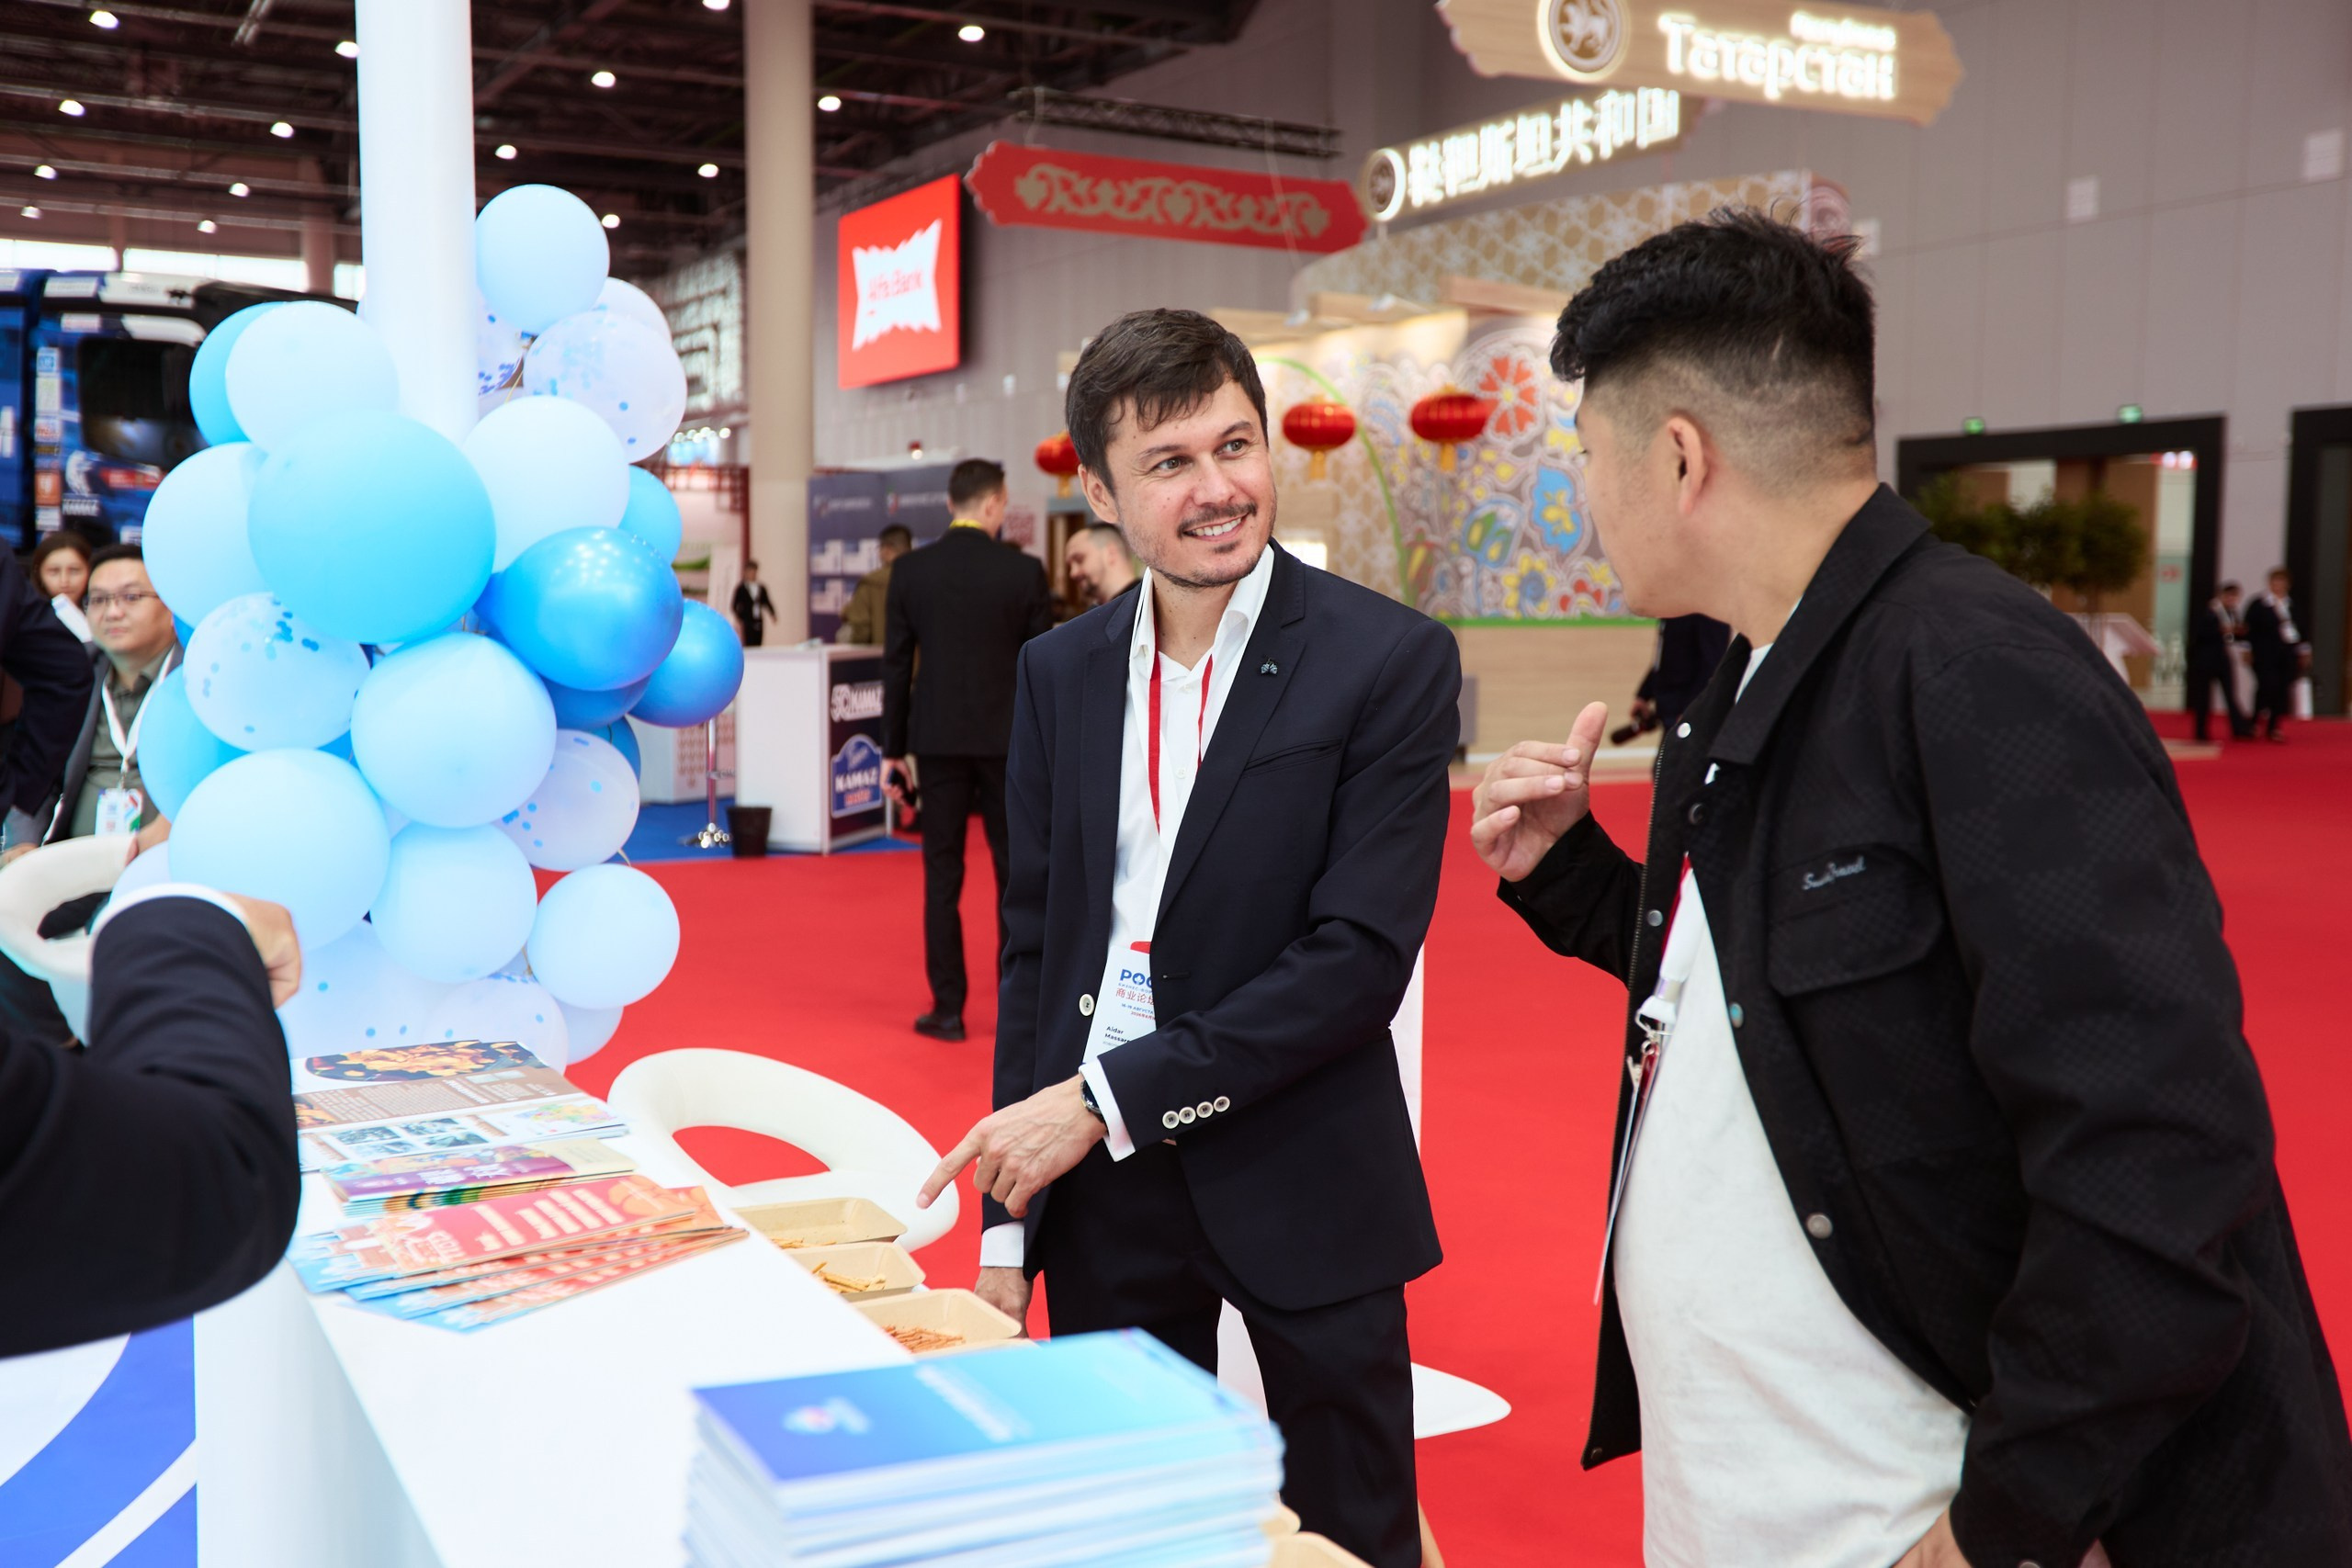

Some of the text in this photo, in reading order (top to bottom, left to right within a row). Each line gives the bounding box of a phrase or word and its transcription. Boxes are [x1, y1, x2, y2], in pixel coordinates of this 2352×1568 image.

[1657, 13, 1896, 101] Татарстан
[835, 768, 878, 793] KAMAZ
[1106, 1026, 1124, 1034] Aidar
